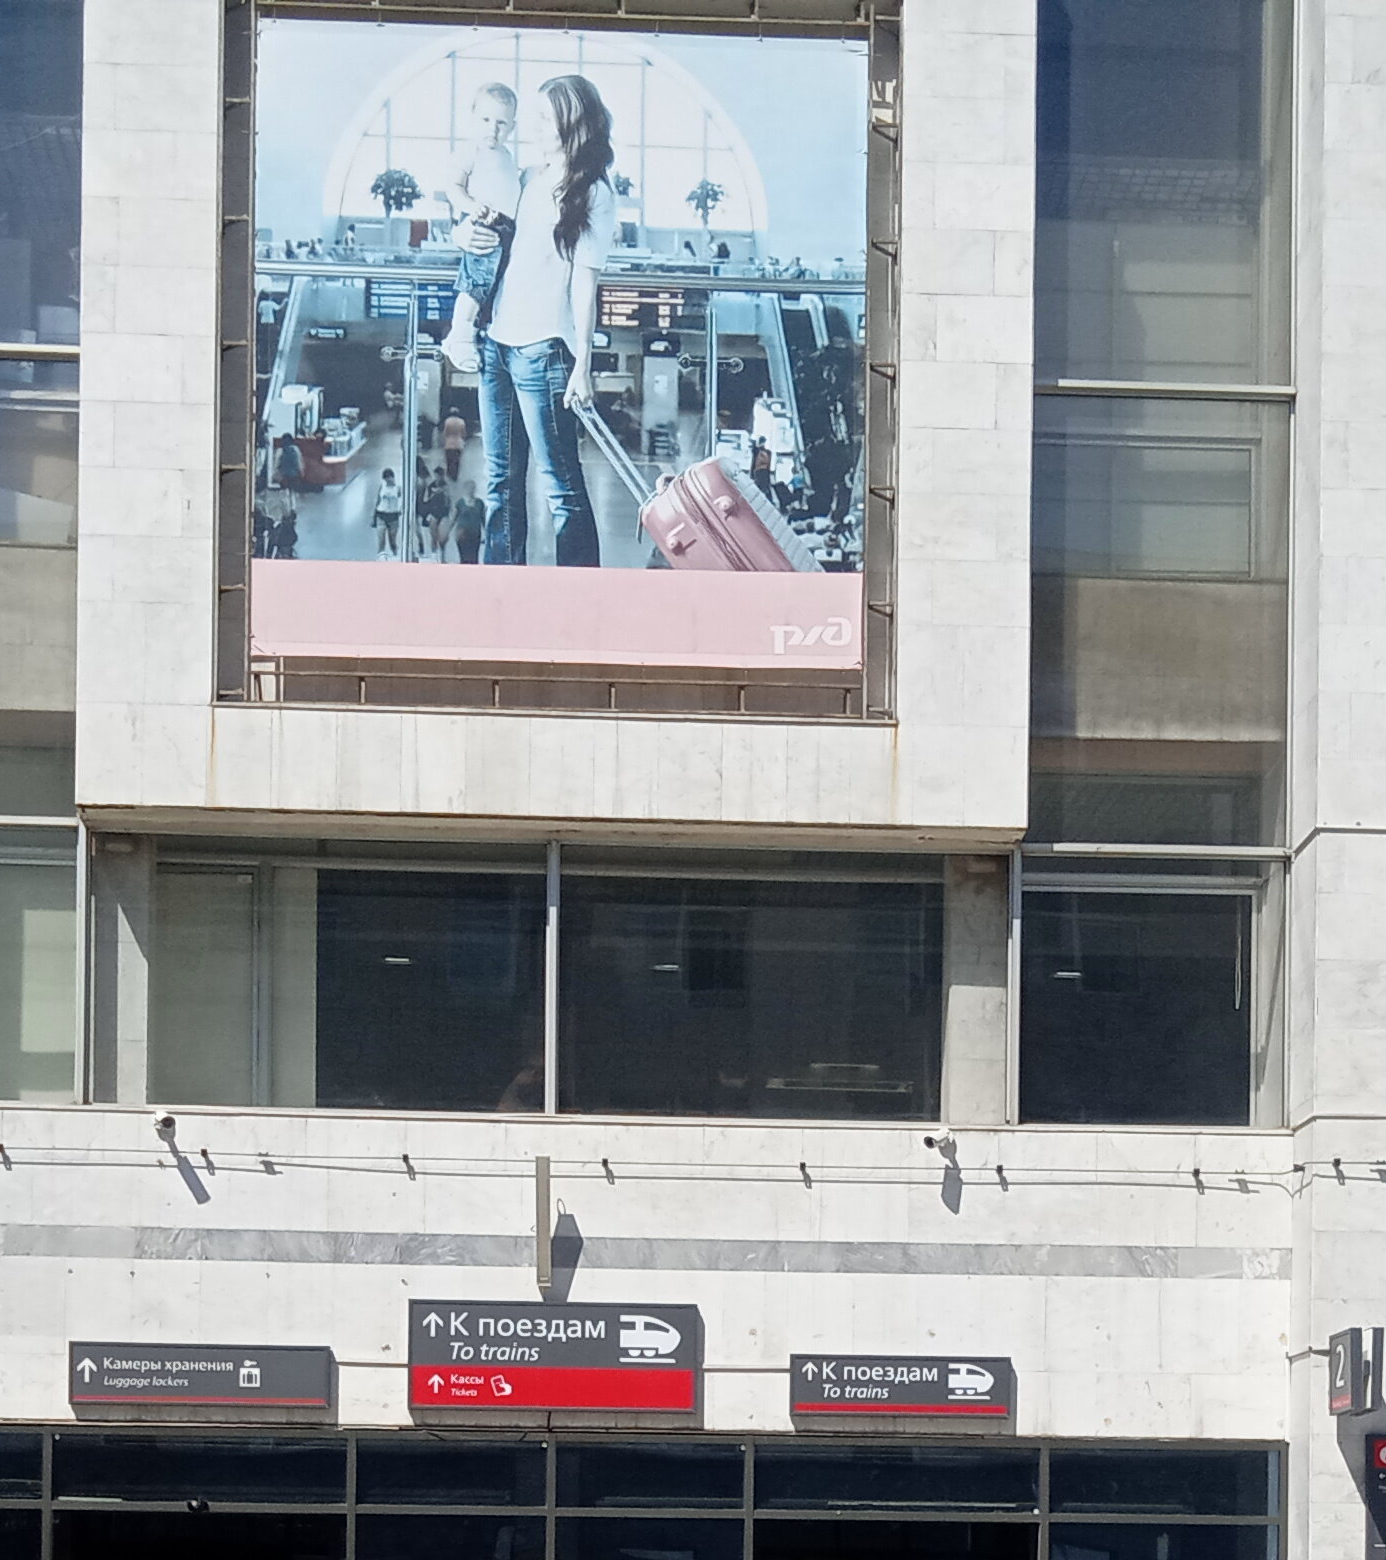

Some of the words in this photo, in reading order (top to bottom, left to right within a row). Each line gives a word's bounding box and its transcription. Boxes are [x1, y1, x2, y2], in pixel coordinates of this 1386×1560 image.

[450, 1311, 471, 1337] К
[478, 1317, 606, 1342] поездам
[449, 1342, 474, 1361] To
[480, 1342, 540, 1362] trains
[103, 1357, 162, 1372] Камеры
[164, 1360, 234, 1373] хранения
[822, 1361, 838, 1381] К
[843, 1366, 938, 1384] поездам
[103, 1376, 151, 1388] Luggage
[152, 1376, 189, 1388] lockers
[450, 1374, 485, 1385] Кассы
[822, 1384, 841, 1399] To
[844, 1383, 890, 1400] trains
